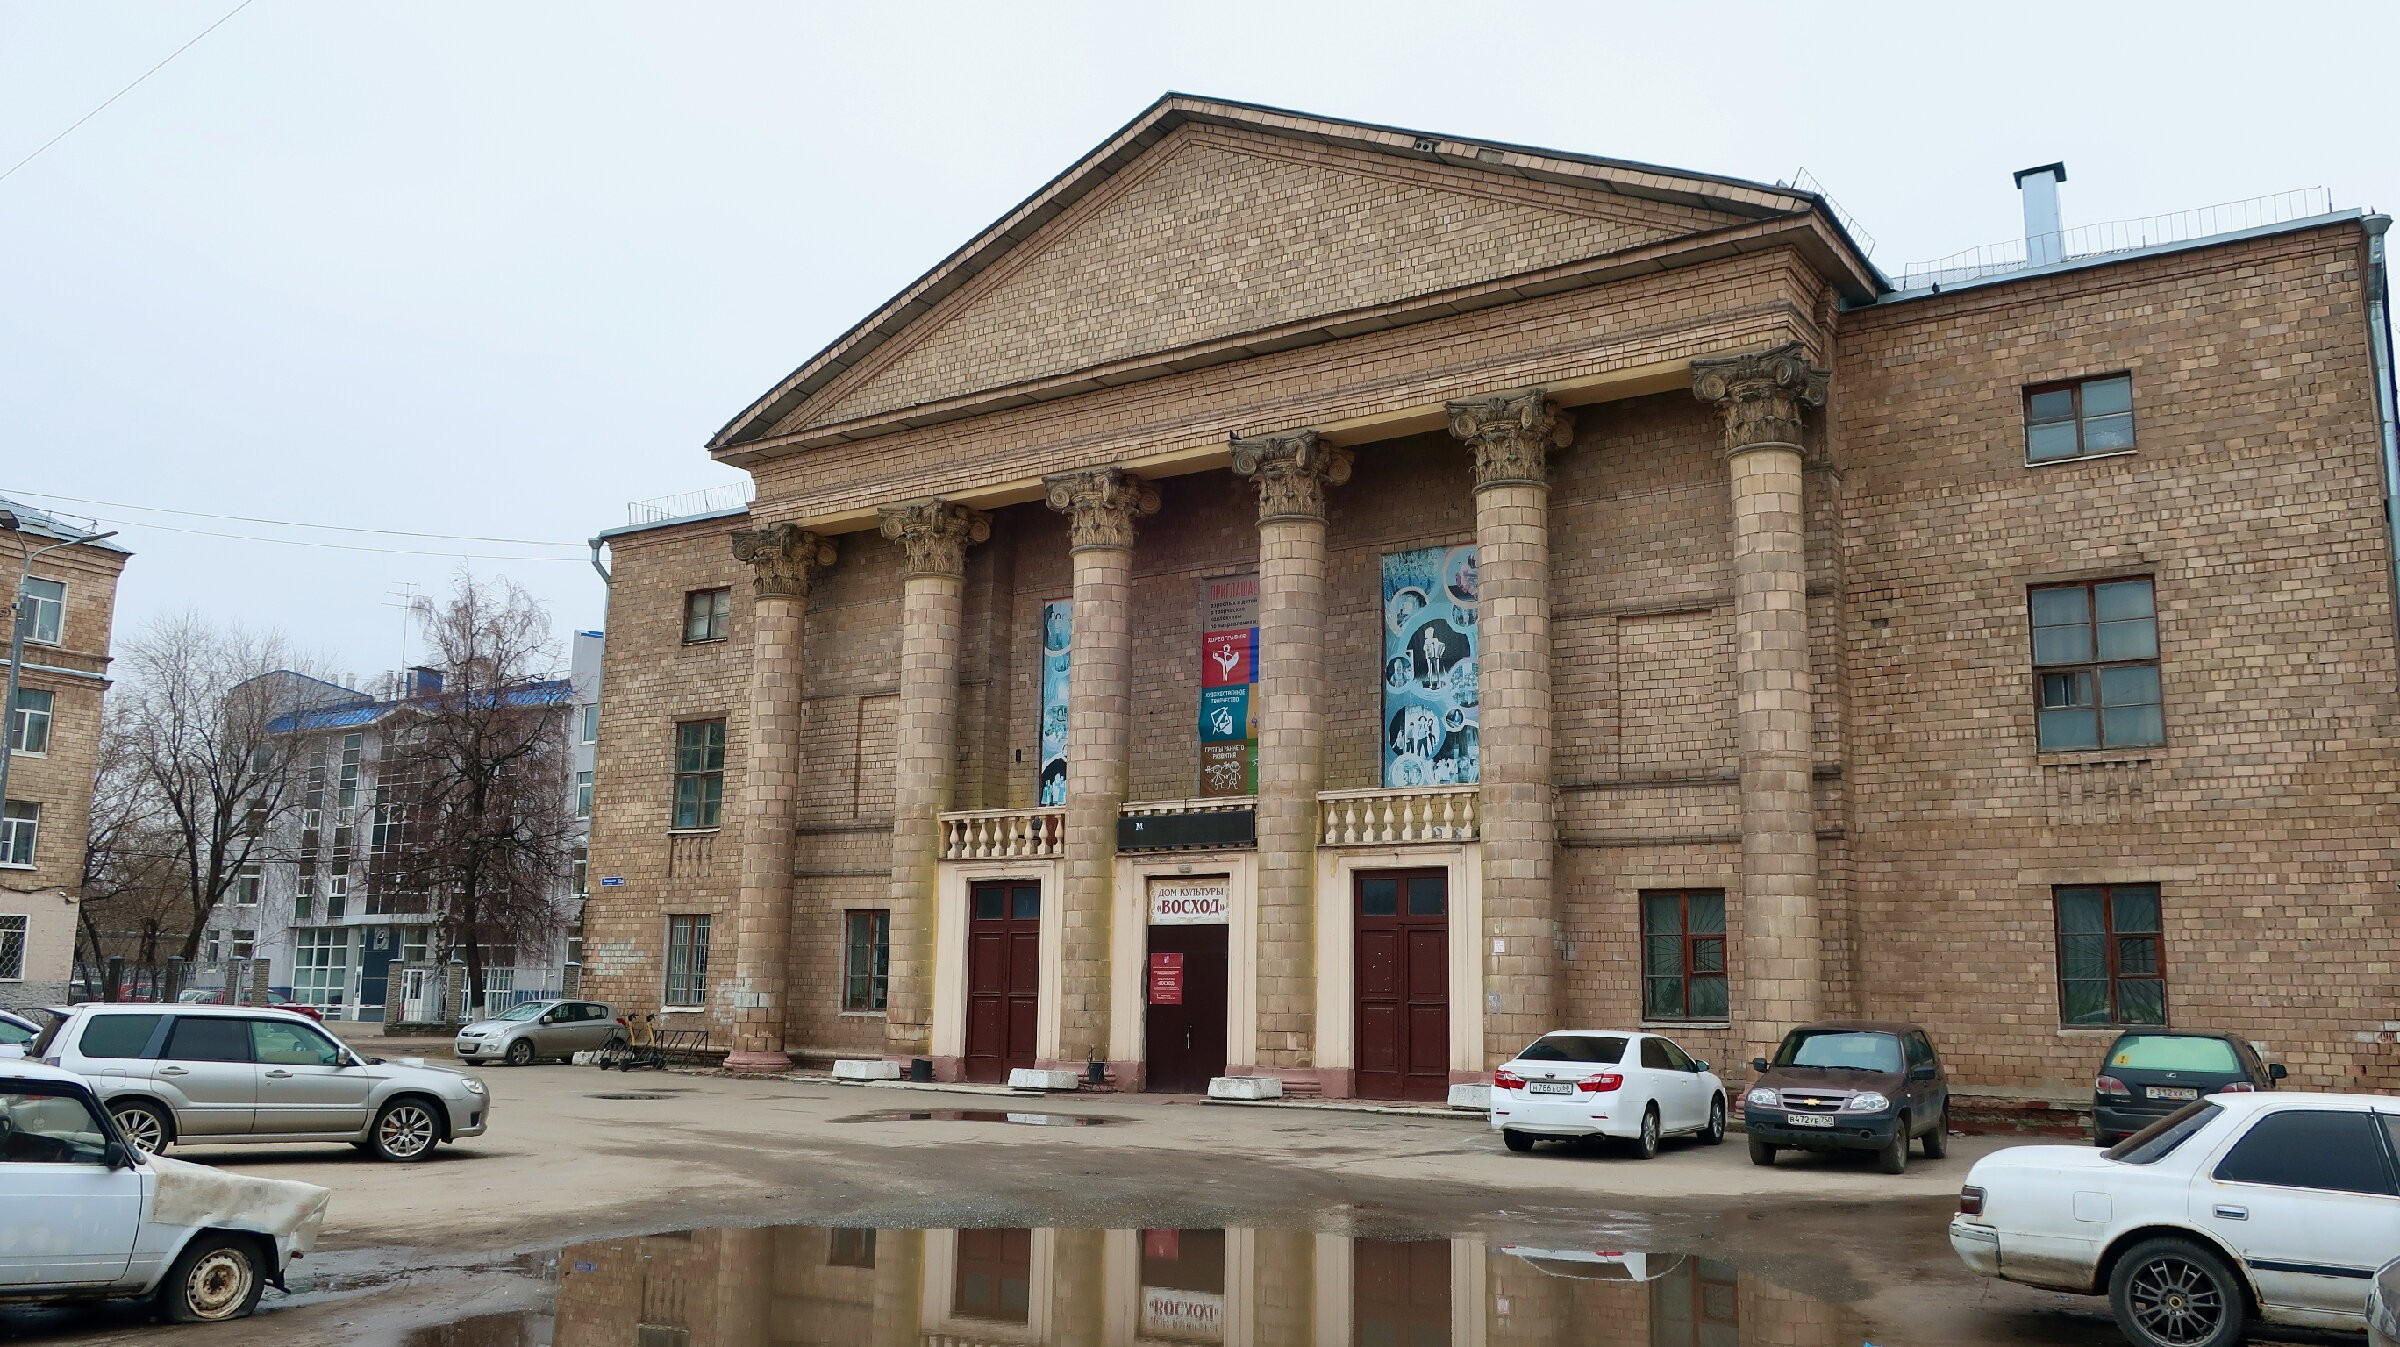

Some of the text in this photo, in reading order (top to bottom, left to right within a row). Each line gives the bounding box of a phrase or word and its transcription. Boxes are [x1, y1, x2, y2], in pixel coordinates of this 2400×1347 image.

[1210, 580, 1260, 601] ПРИГЛАШАЕ
[1158, 887, 1224, 898] ДОМ КУЛЬТУРЫ
[1157, 898, 1226, 916] «ВОСХОД»
